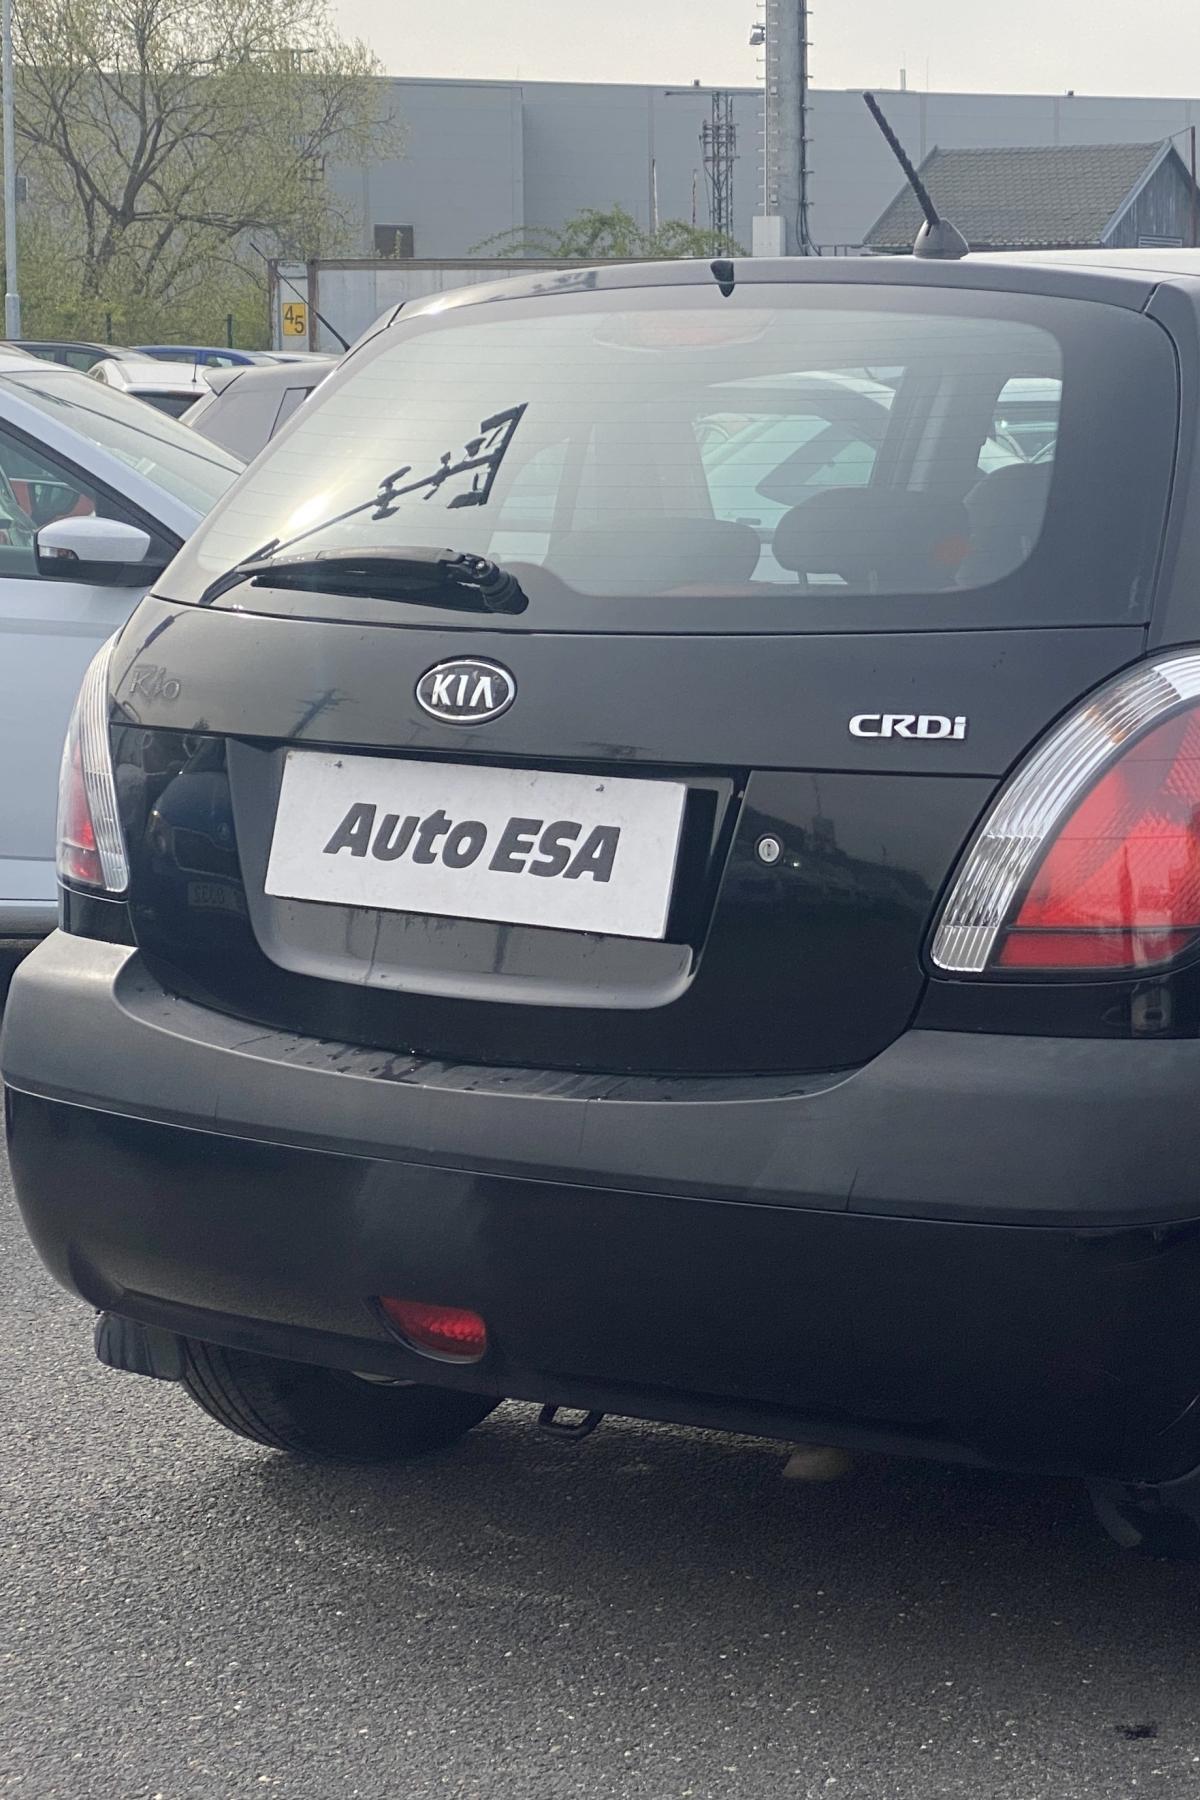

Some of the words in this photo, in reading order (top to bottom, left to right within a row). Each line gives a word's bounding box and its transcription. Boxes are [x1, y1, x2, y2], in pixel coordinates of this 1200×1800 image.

[430, 673, 494, 709] KIA
[849, 713, 967, 740] CRDi
[322, 802, 488, 869] Auto
[488, 817, 621, 882] ESA
